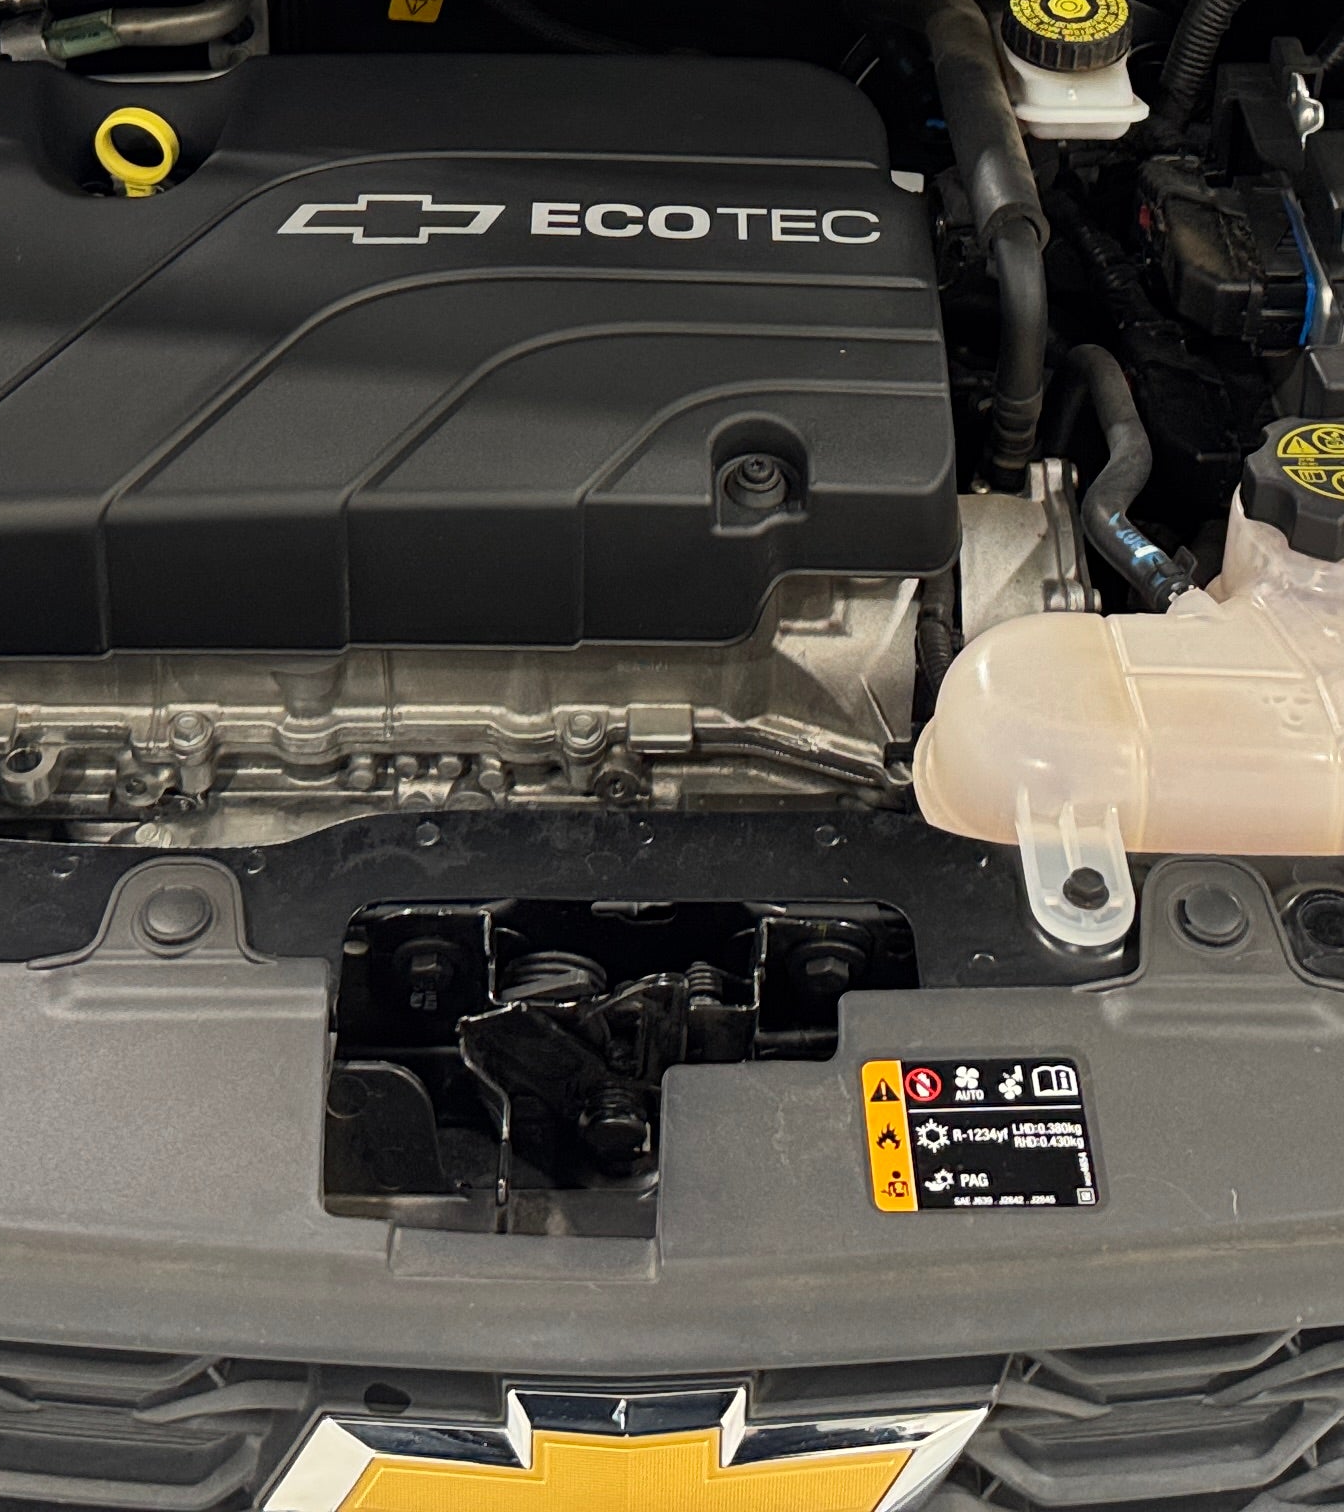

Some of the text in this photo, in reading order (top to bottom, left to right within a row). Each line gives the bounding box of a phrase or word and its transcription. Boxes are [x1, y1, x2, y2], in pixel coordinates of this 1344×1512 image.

[530, 201, 882, 245] ECOTEC
[954, 1089, 985, 1101] AUTO
[952, 1126, 1009, 1144] R-1234yf
[959, 1172, 990, 1187] PAG
[953, 1195, 972, 1206] SAE
